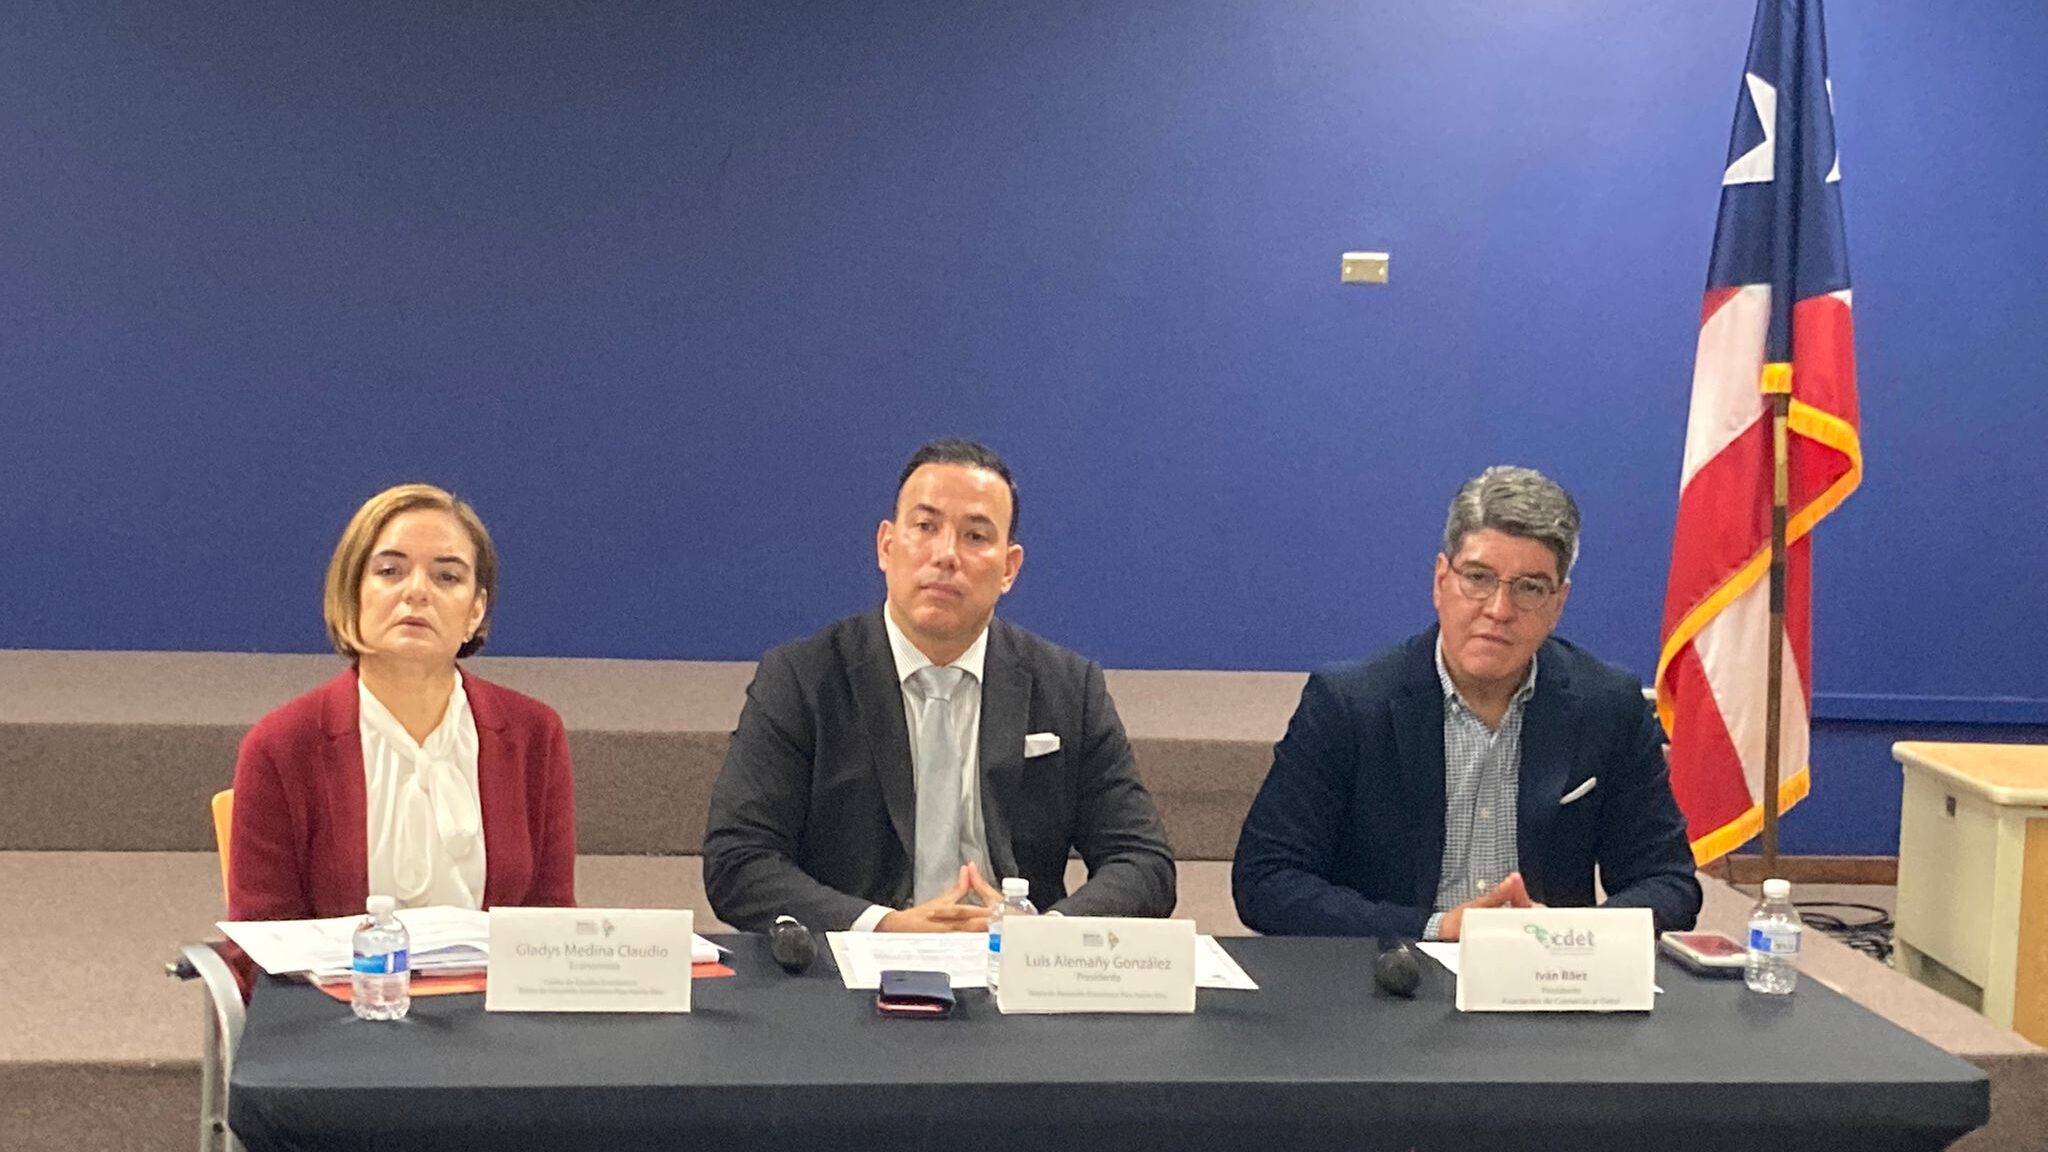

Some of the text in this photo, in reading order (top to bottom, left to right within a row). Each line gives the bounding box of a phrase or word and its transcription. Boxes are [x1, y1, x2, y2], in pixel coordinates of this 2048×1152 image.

[516, 943, 669, 959] Gladys Medina Claudio
[1025, 954, 1172, 971] Luis Alemañy González
[1077, 972, 1121, 982] Presidente
[1535, 970, 1588, 981] Iván Báez
